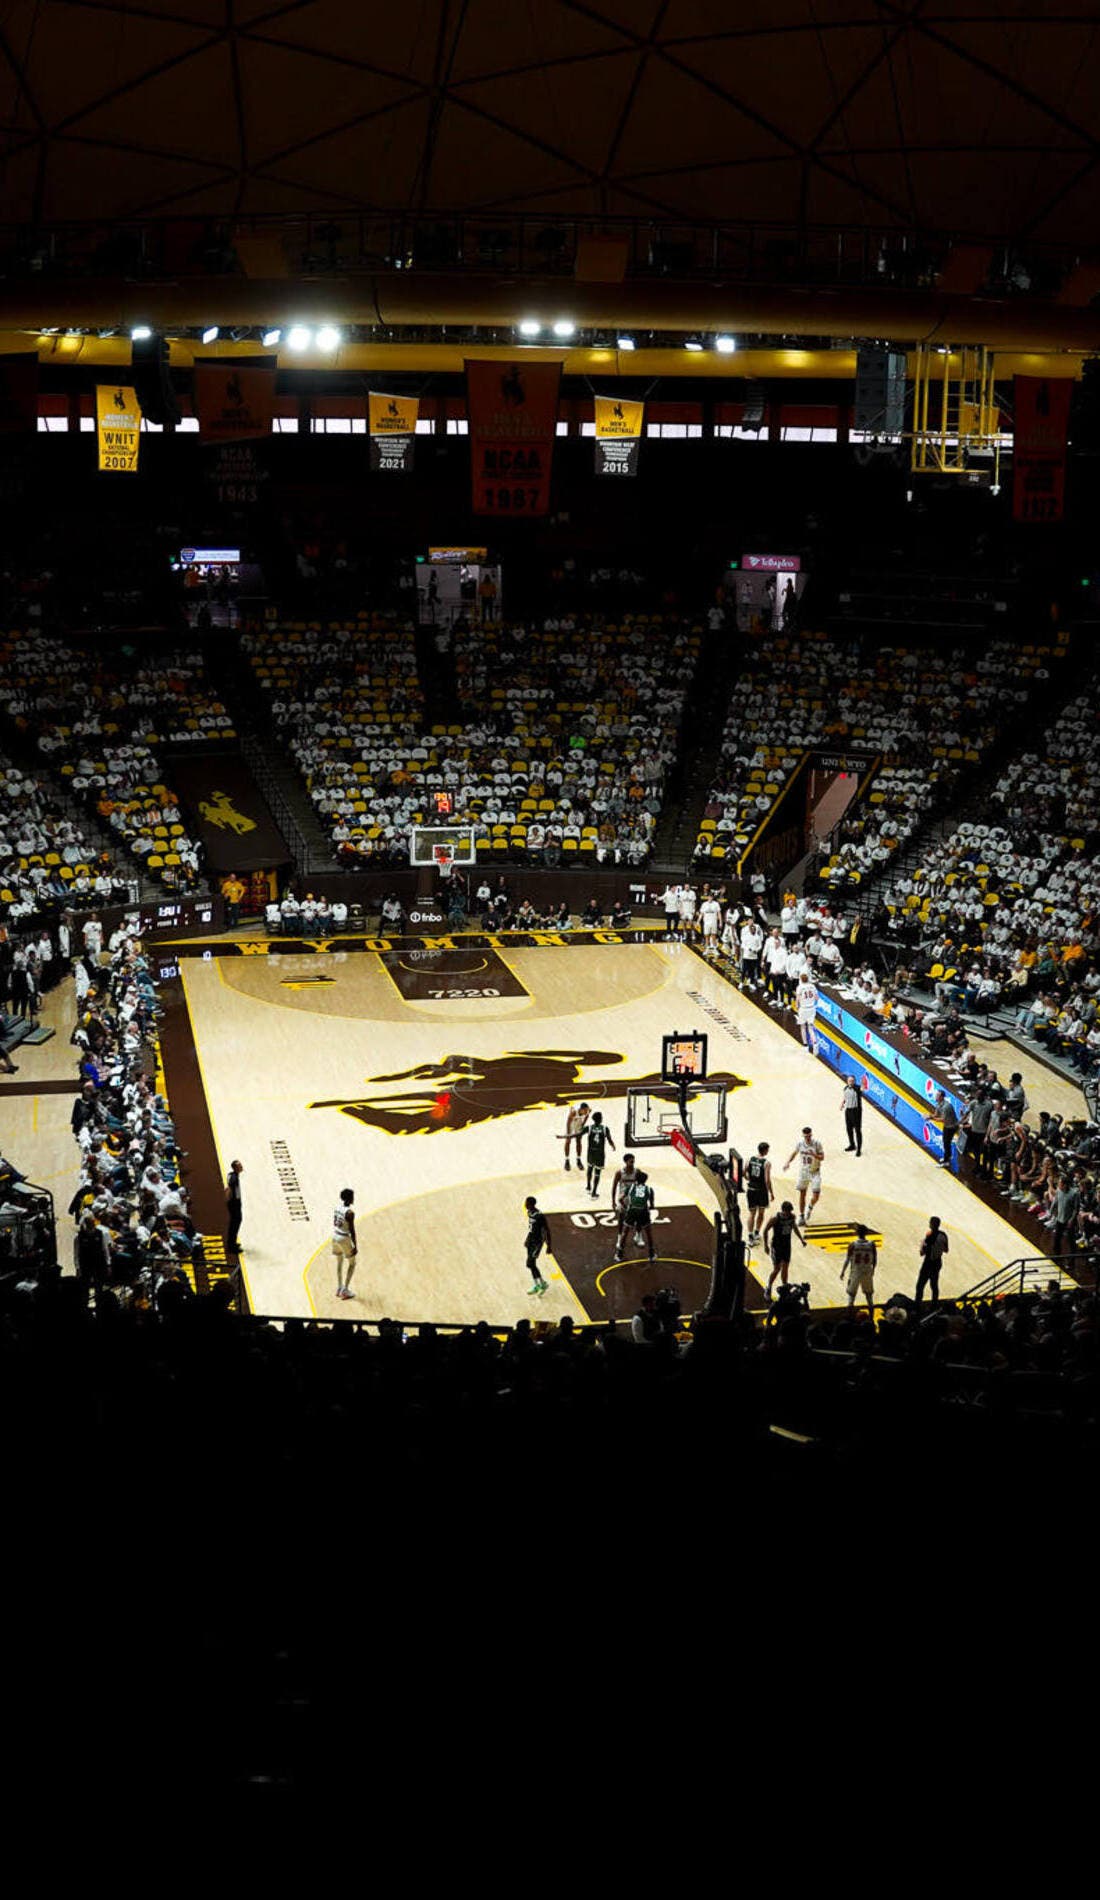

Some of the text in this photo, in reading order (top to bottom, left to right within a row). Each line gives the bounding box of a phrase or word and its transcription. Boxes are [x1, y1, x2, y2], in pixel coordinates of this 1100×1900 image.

[104, 432, 136, 445] WNIT
[105, 456, 134, 469] 2007
[379, 457, 405, 469] 2021
[485, 448, 539, 468] NCAA
[602, 461, 629, 473] 2015
[485, 487, 540, 507] 1987
[235, 931, 623, 956] WYOMING
[428, 988, 500, 999] 7220
[570, 1209, 671, 1228] 720
